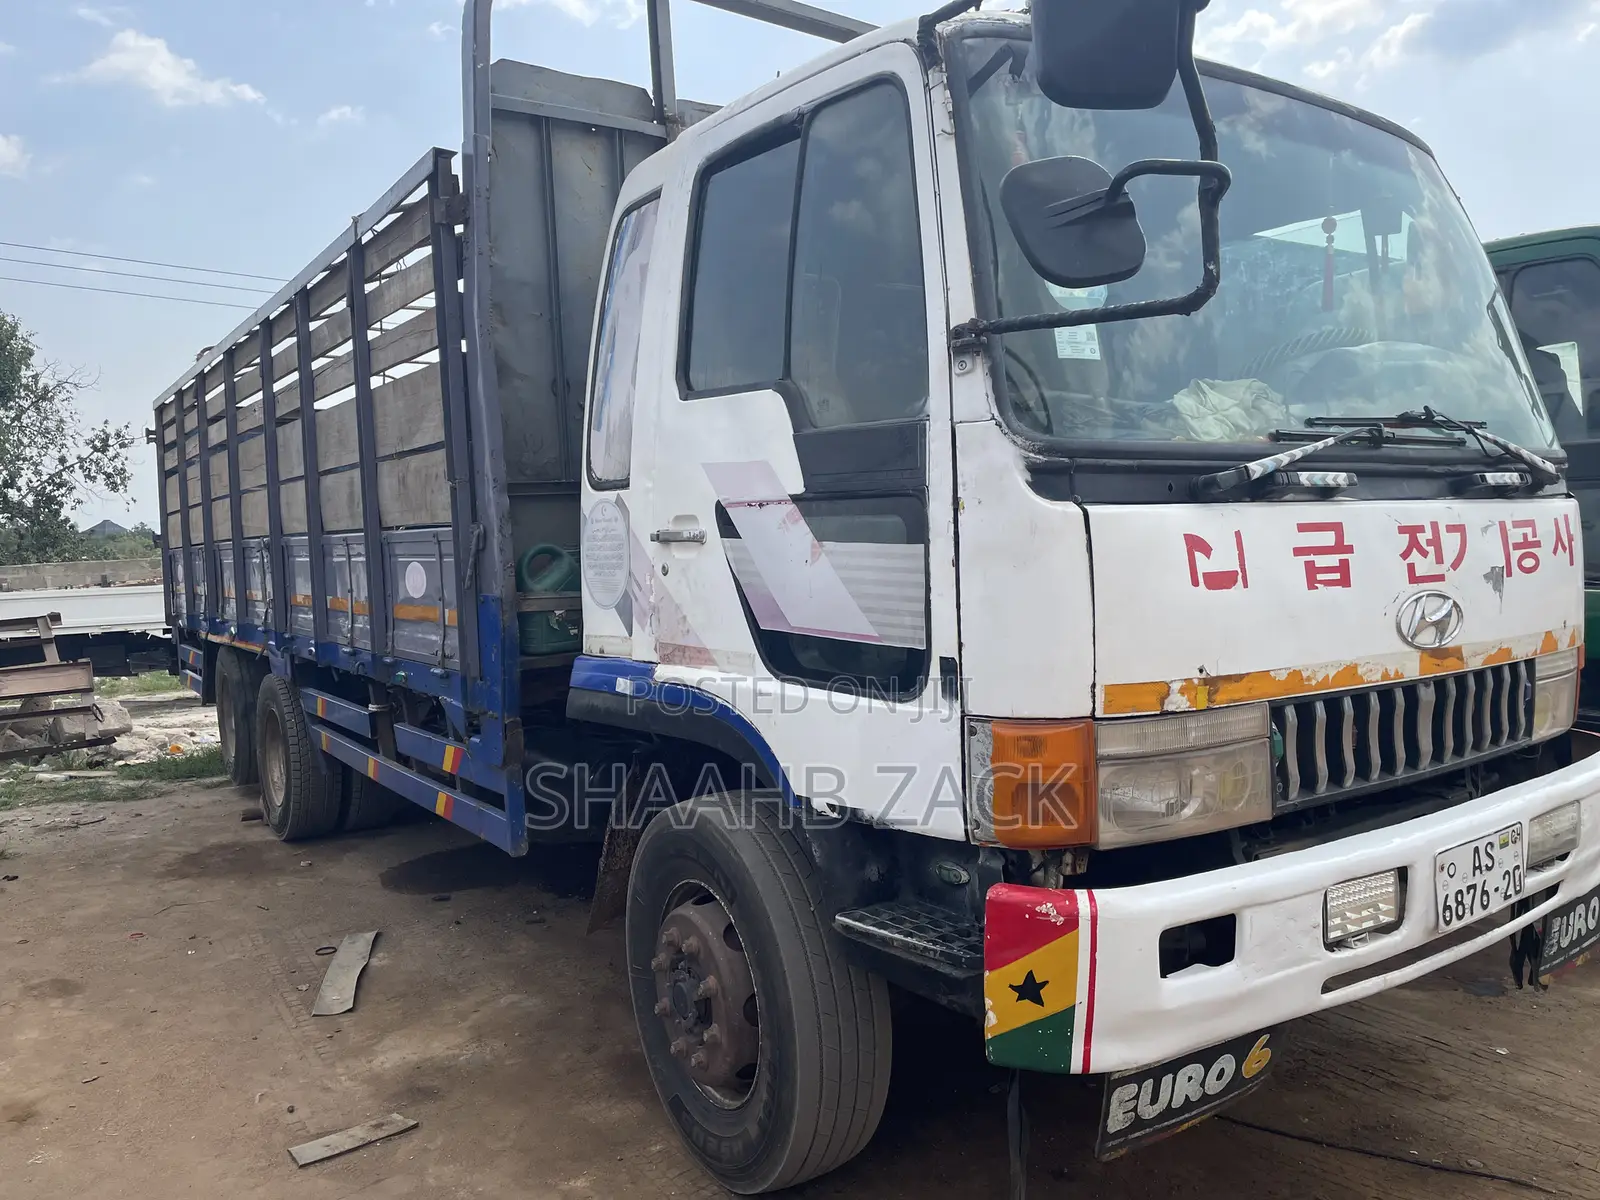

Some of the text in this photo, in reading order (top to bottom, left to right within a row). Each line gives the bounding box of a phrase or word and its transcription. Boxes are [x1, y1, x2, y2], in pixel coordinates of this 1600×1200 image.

[1472, 840, 1496, 878] AS
[1441, 863, 1523, 927] 6876-20
[1106, 1033, 1272, 1135] EURO 6
